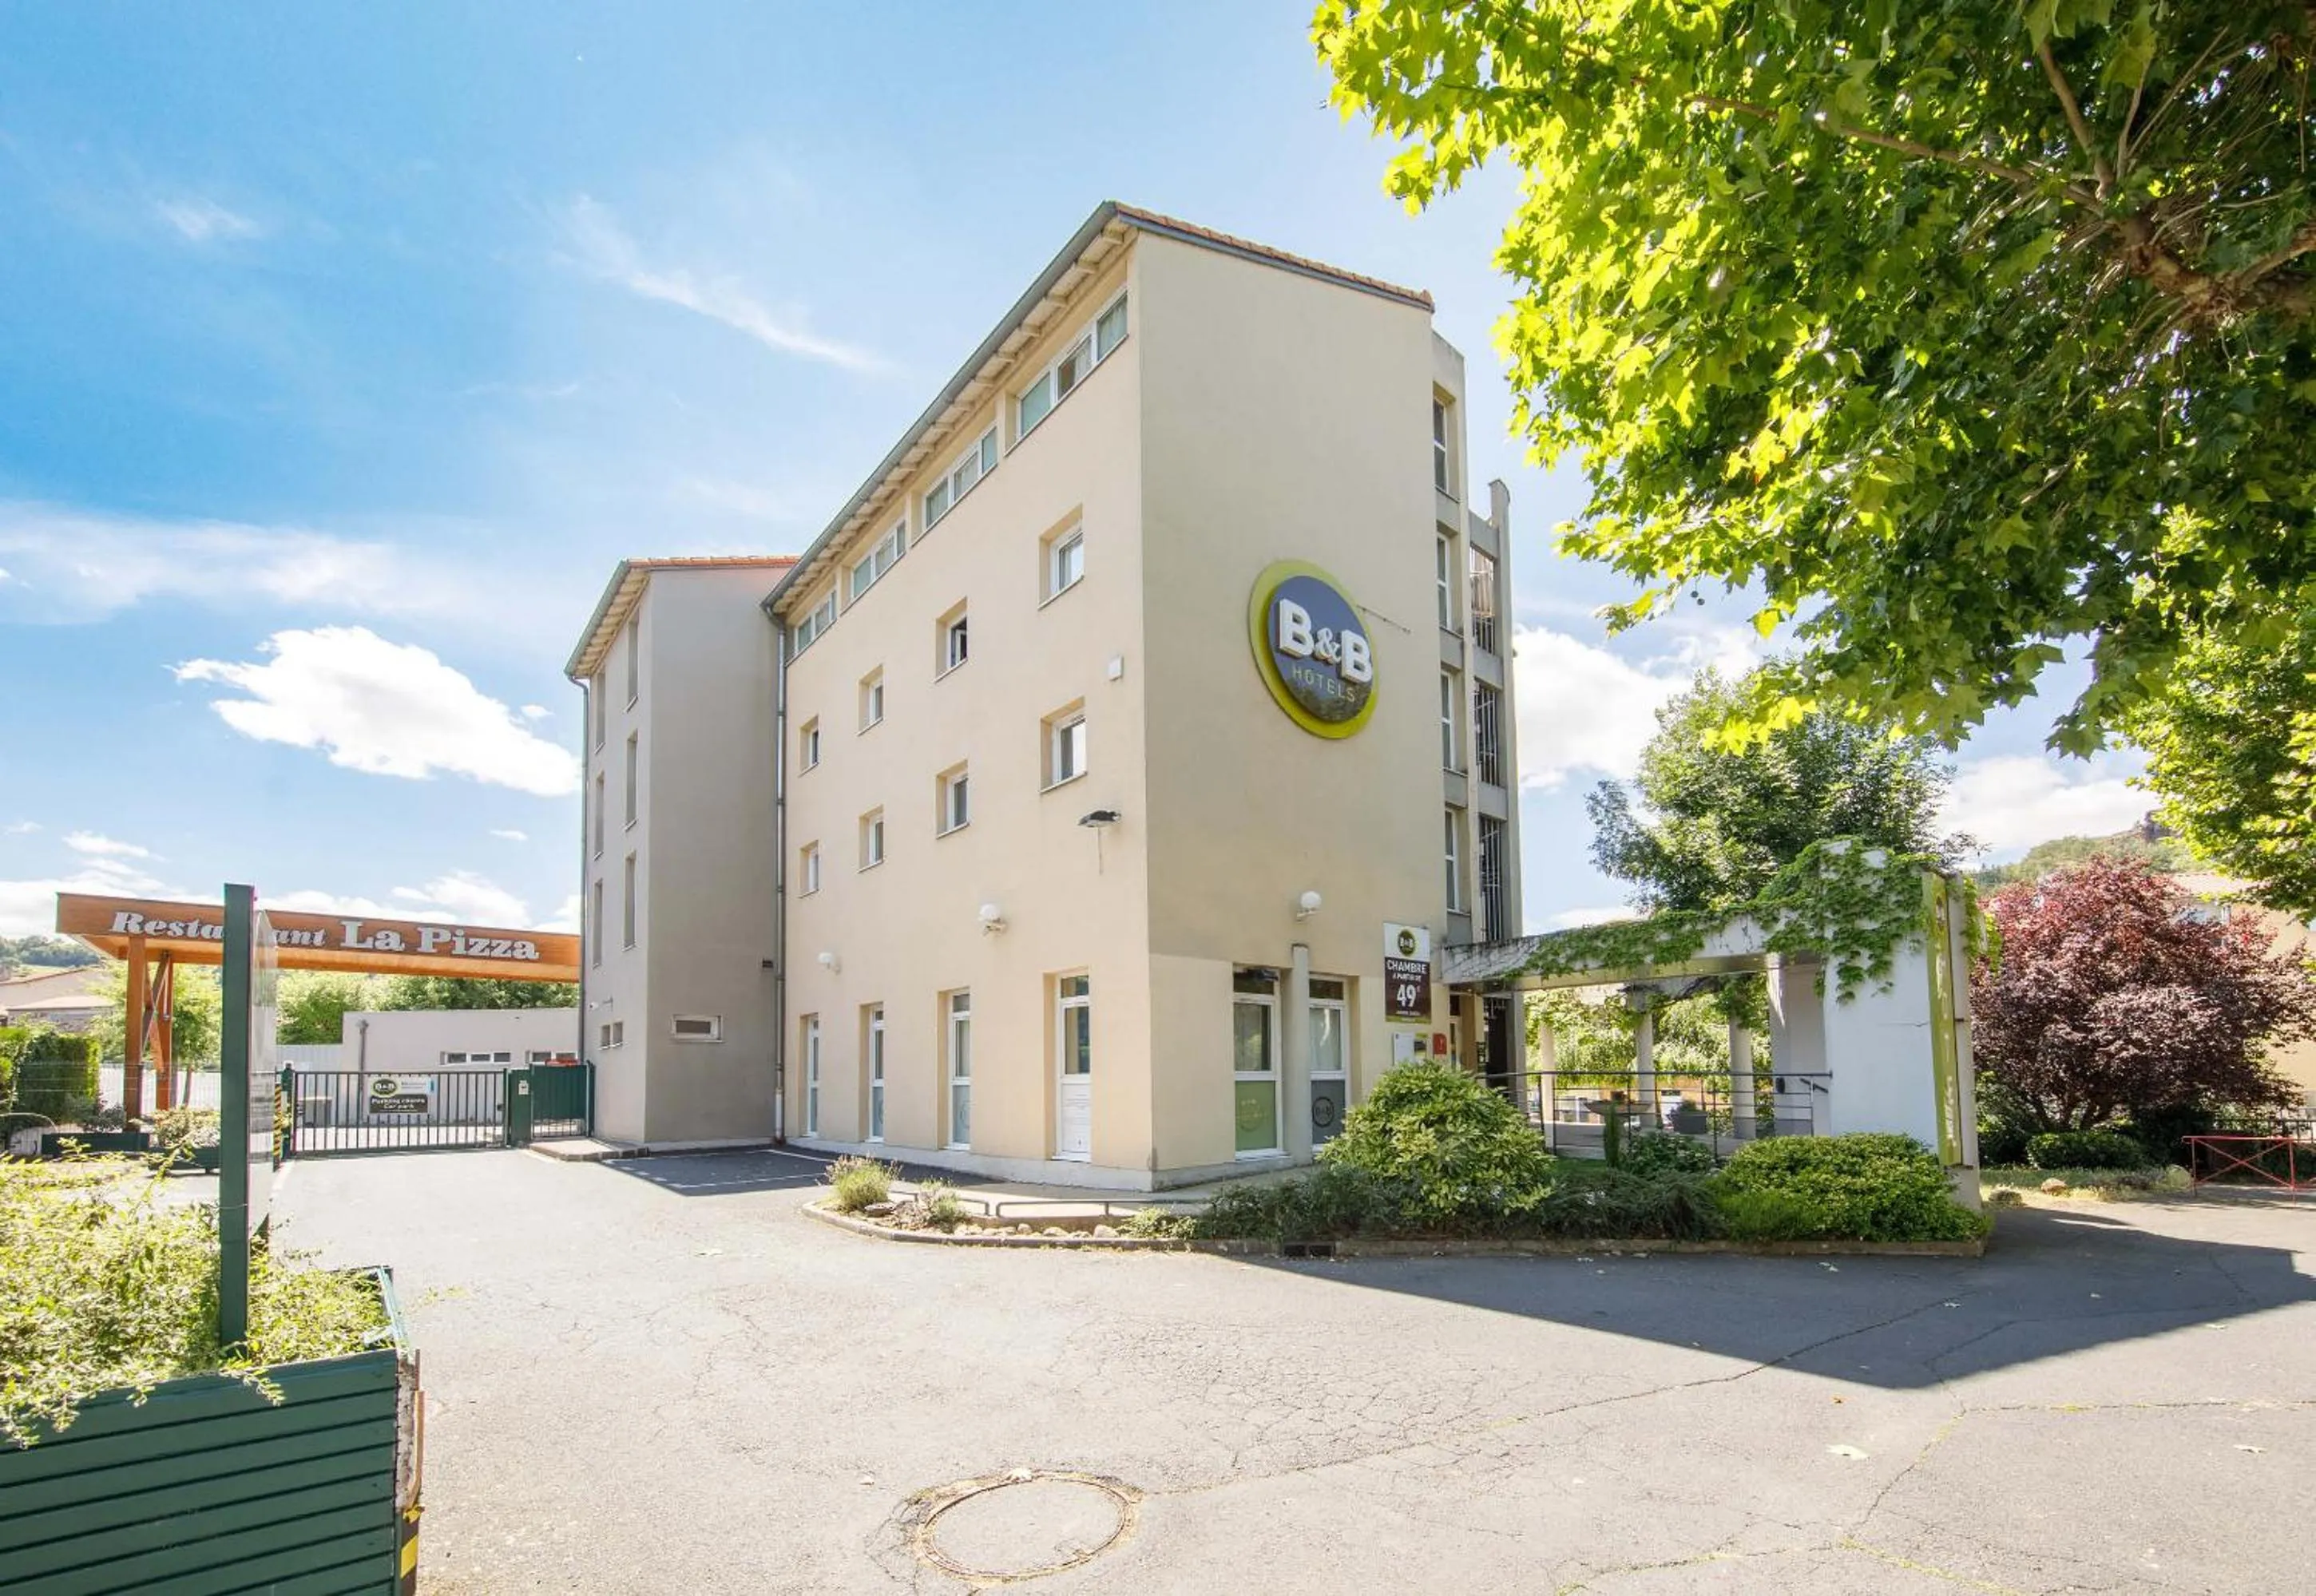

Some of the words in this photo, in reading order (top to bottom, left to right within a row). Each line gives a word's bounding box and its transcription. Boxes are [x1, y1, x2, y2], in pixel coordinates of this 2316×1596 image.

[1279, 598, 1374, 684] B&B
[109, 911, 326, 947] Restaant
[339, 920, 406, 952] La
[417, 926, 540, 960] Pizza
[1386, 959, 1428, 974] CHAMBRE
